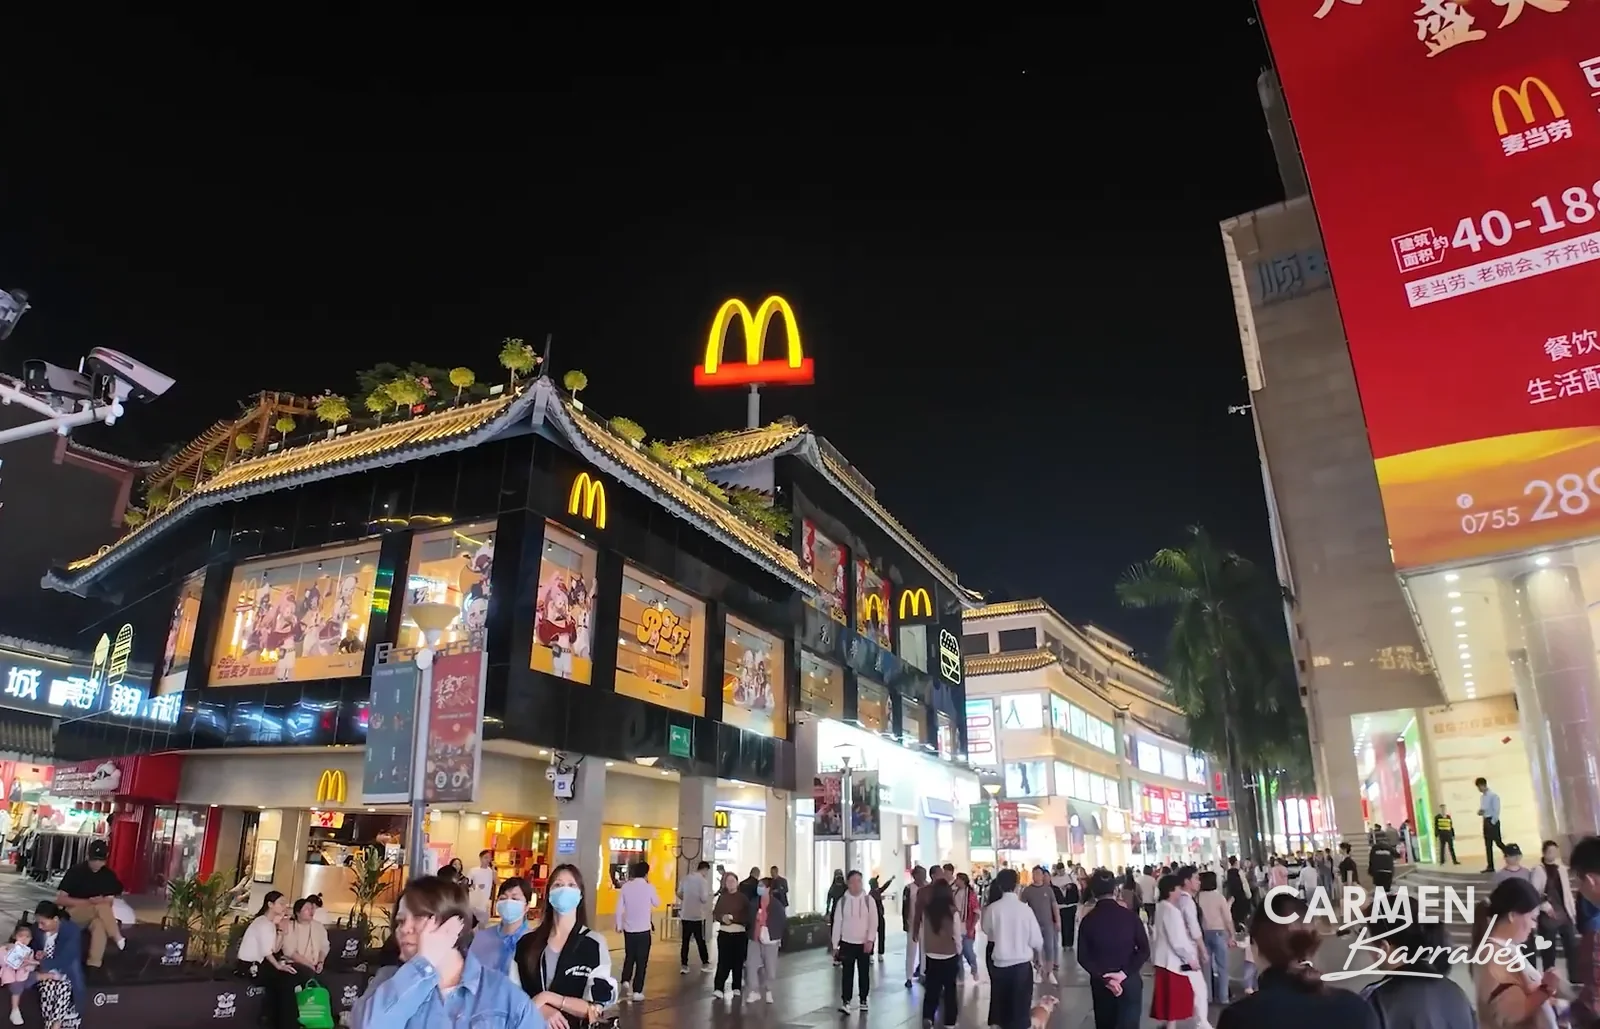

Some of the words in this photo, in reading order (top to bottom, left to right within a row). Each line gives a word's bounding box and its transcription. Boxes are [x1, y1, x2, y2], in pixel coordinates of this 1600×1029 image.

[1500, 119, 1573, 156] 麦当劳
[1451, 180, 1600, 253] 40-18
[1398, 232, 1431, 254] 建筑
[1431, 235, 1450, 251] 约
[1402, 247, 1436, 268] 面积
[1543, 329, 1600, 362] 餐饮
[1461, 506, 1520, 534] 0755
